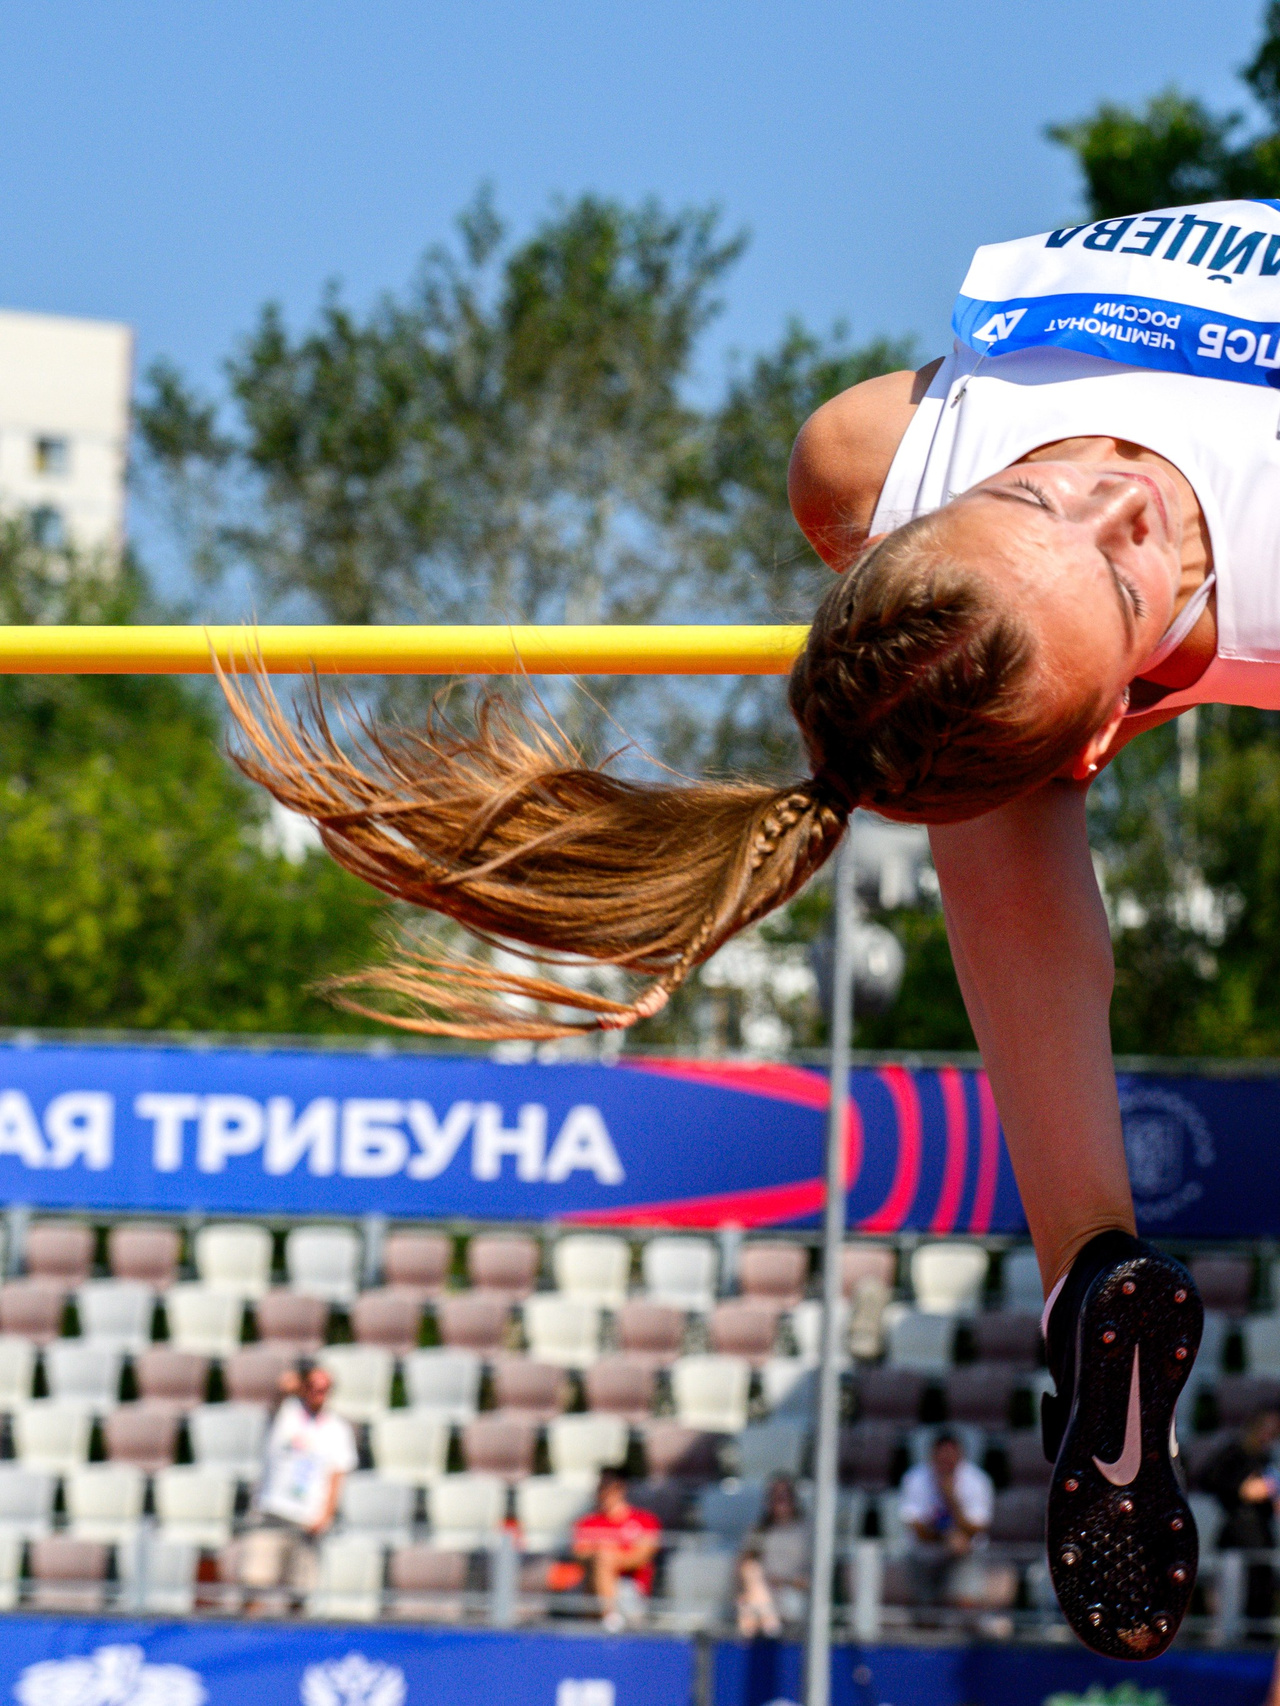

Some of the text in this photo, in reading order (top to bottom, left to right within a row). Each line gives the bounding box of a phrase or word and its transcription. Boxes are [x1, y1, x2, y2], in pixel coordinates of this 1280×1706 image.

[1044, 316, 1176, 351] ЧЕМПИОНАТ
[1092, 302, 1182, 330] РОССИИ
[134, 1091, 626, 1186] ТРИБУНА
